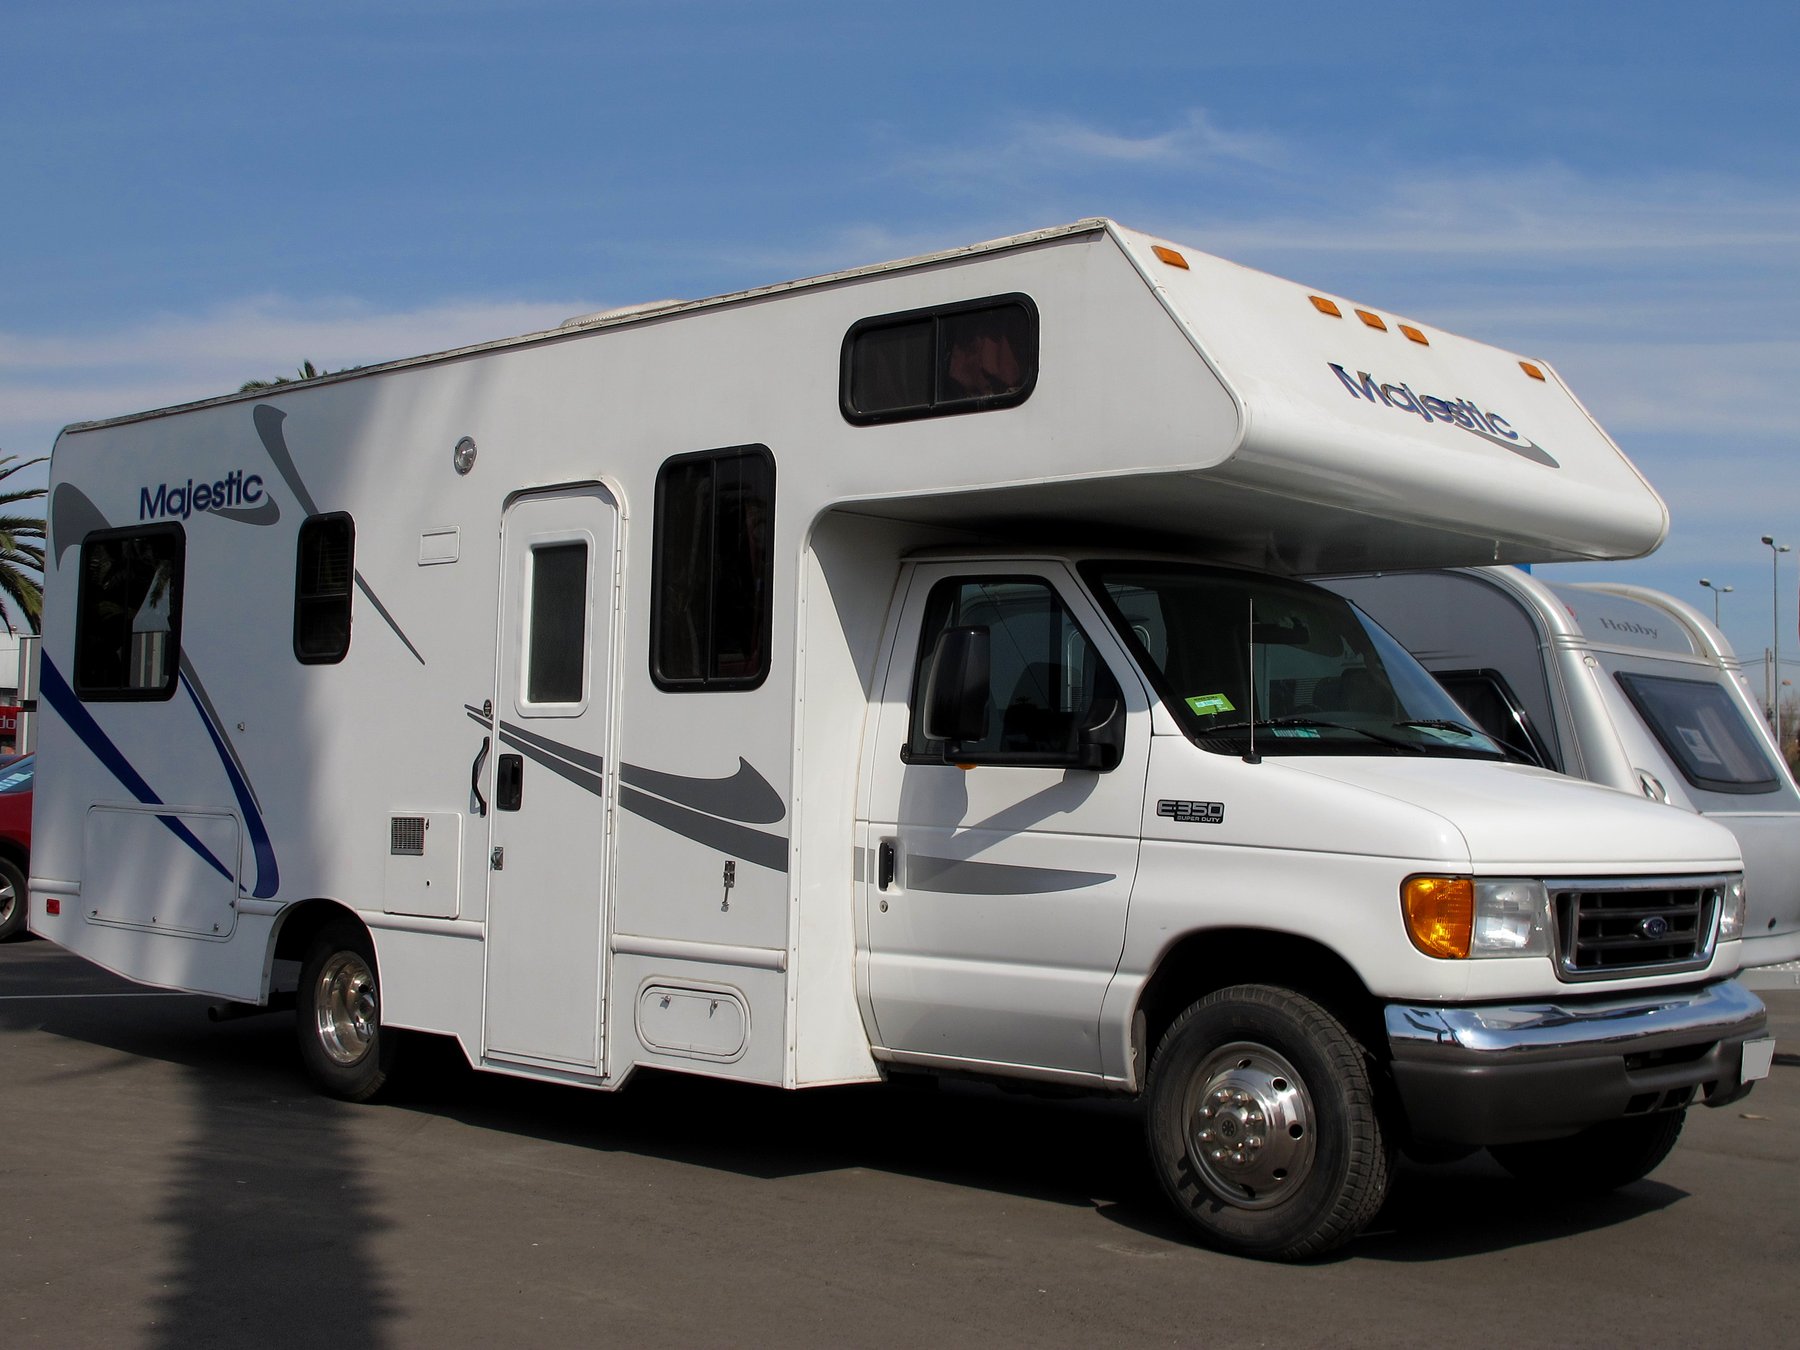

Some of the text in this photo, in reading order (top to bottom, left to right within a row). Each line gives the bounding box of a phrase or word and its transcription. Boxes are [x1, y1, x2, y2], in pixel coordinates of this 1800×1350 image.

[1327, 362, 1519, 440] Majestic
[139, 469, 264, 521] Majestic
[1600, 617, 1658, 640] Hobby
